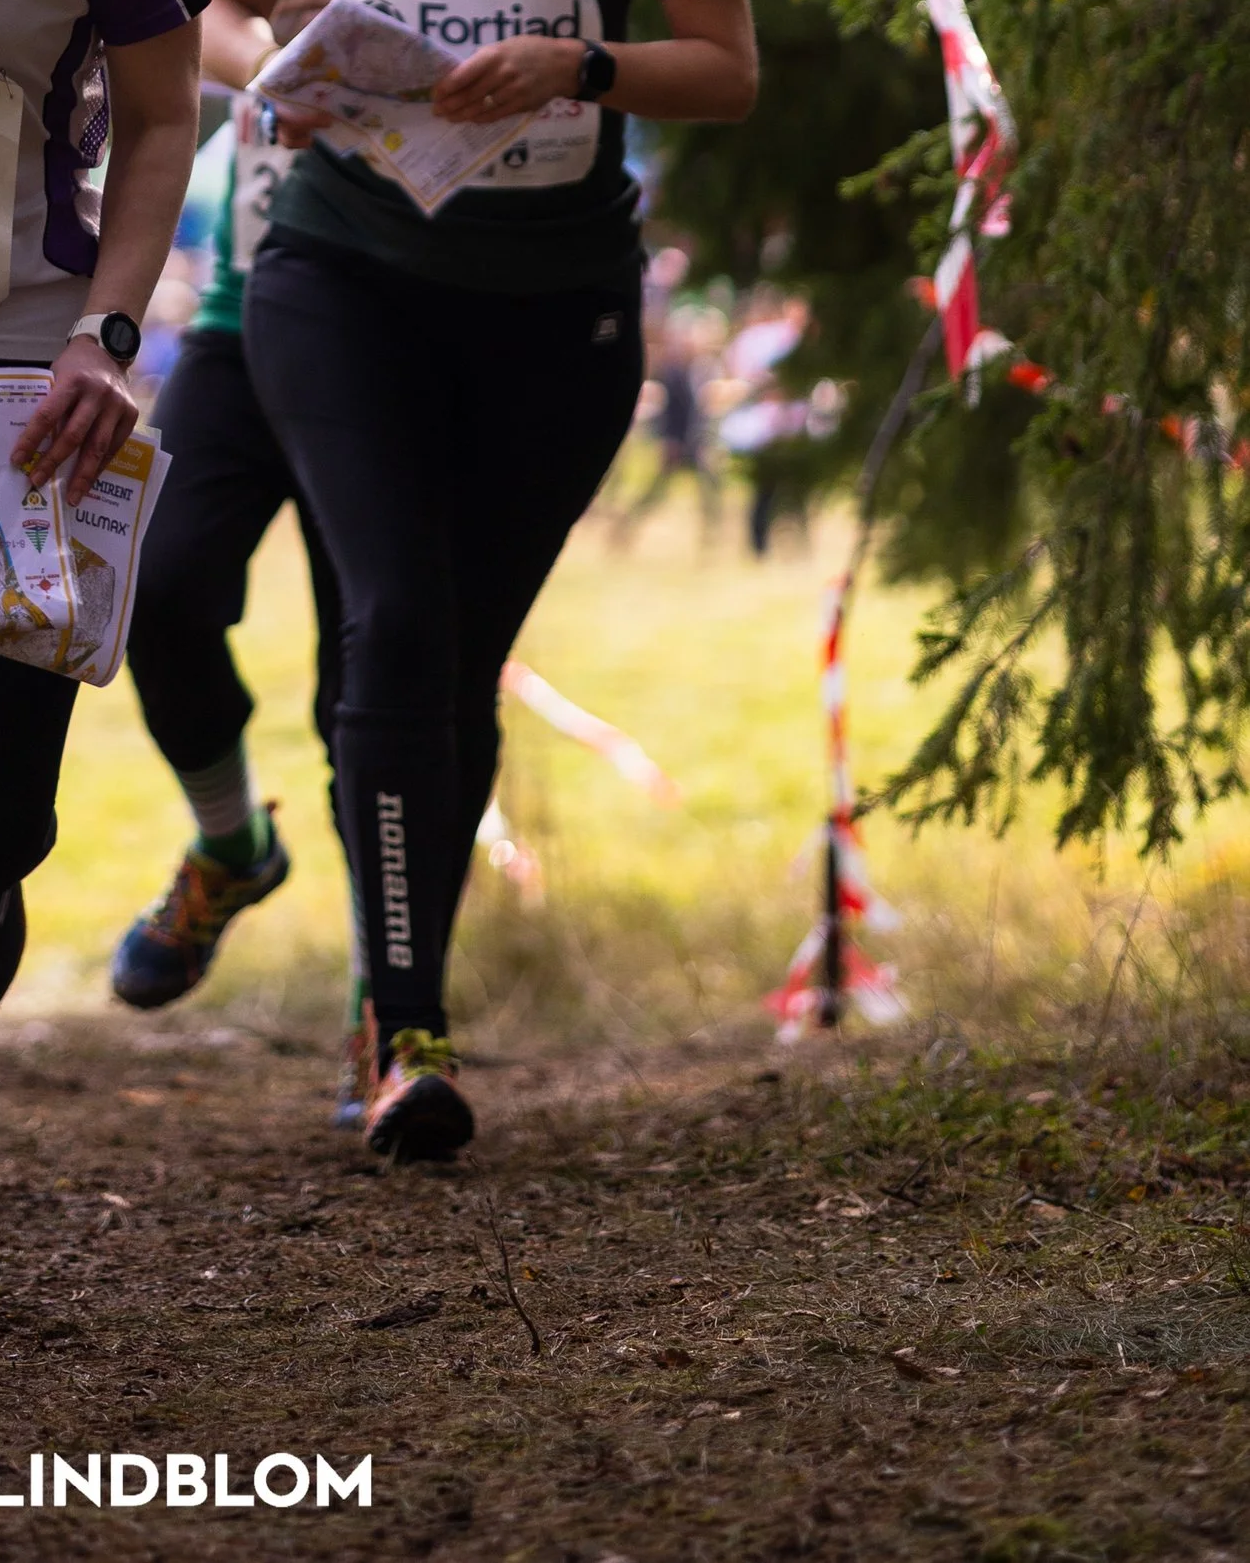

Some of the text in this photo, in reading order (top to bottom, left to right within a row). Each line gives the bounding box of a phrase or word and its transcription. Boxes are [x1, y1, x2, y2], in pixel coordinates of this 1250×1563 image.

[93, 479, 133, 501] MIRENT
[75, 508, 127, 536] ULLMAX
[376, 791, 414, 969] noname
